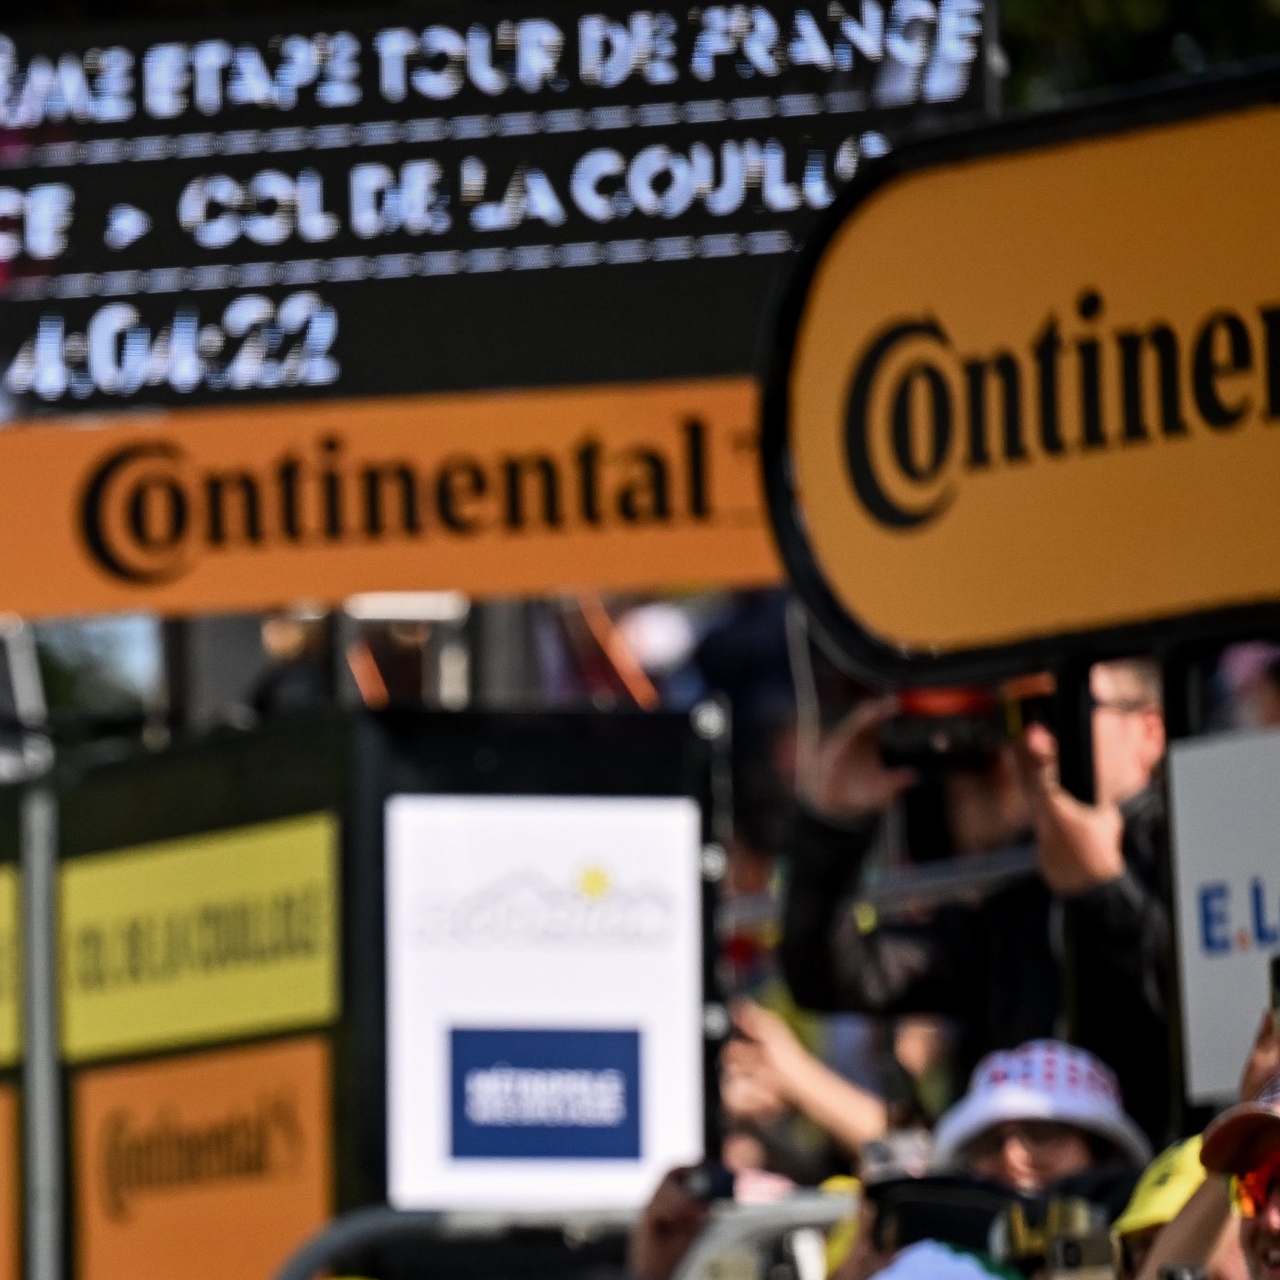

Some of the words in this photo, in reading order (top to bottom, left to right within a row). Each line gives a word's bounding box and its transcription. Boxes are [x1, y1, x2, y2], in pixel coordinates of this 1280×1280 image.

[374, 20, 566, 100] TOUR
[578, 12, 678, 88] DE
[688, 0, 982, 84] FRANCE
[178, 166, 338, 248] COL
[350, 158, 450, 240] DE
[77, 416, 711, 587] Continental
